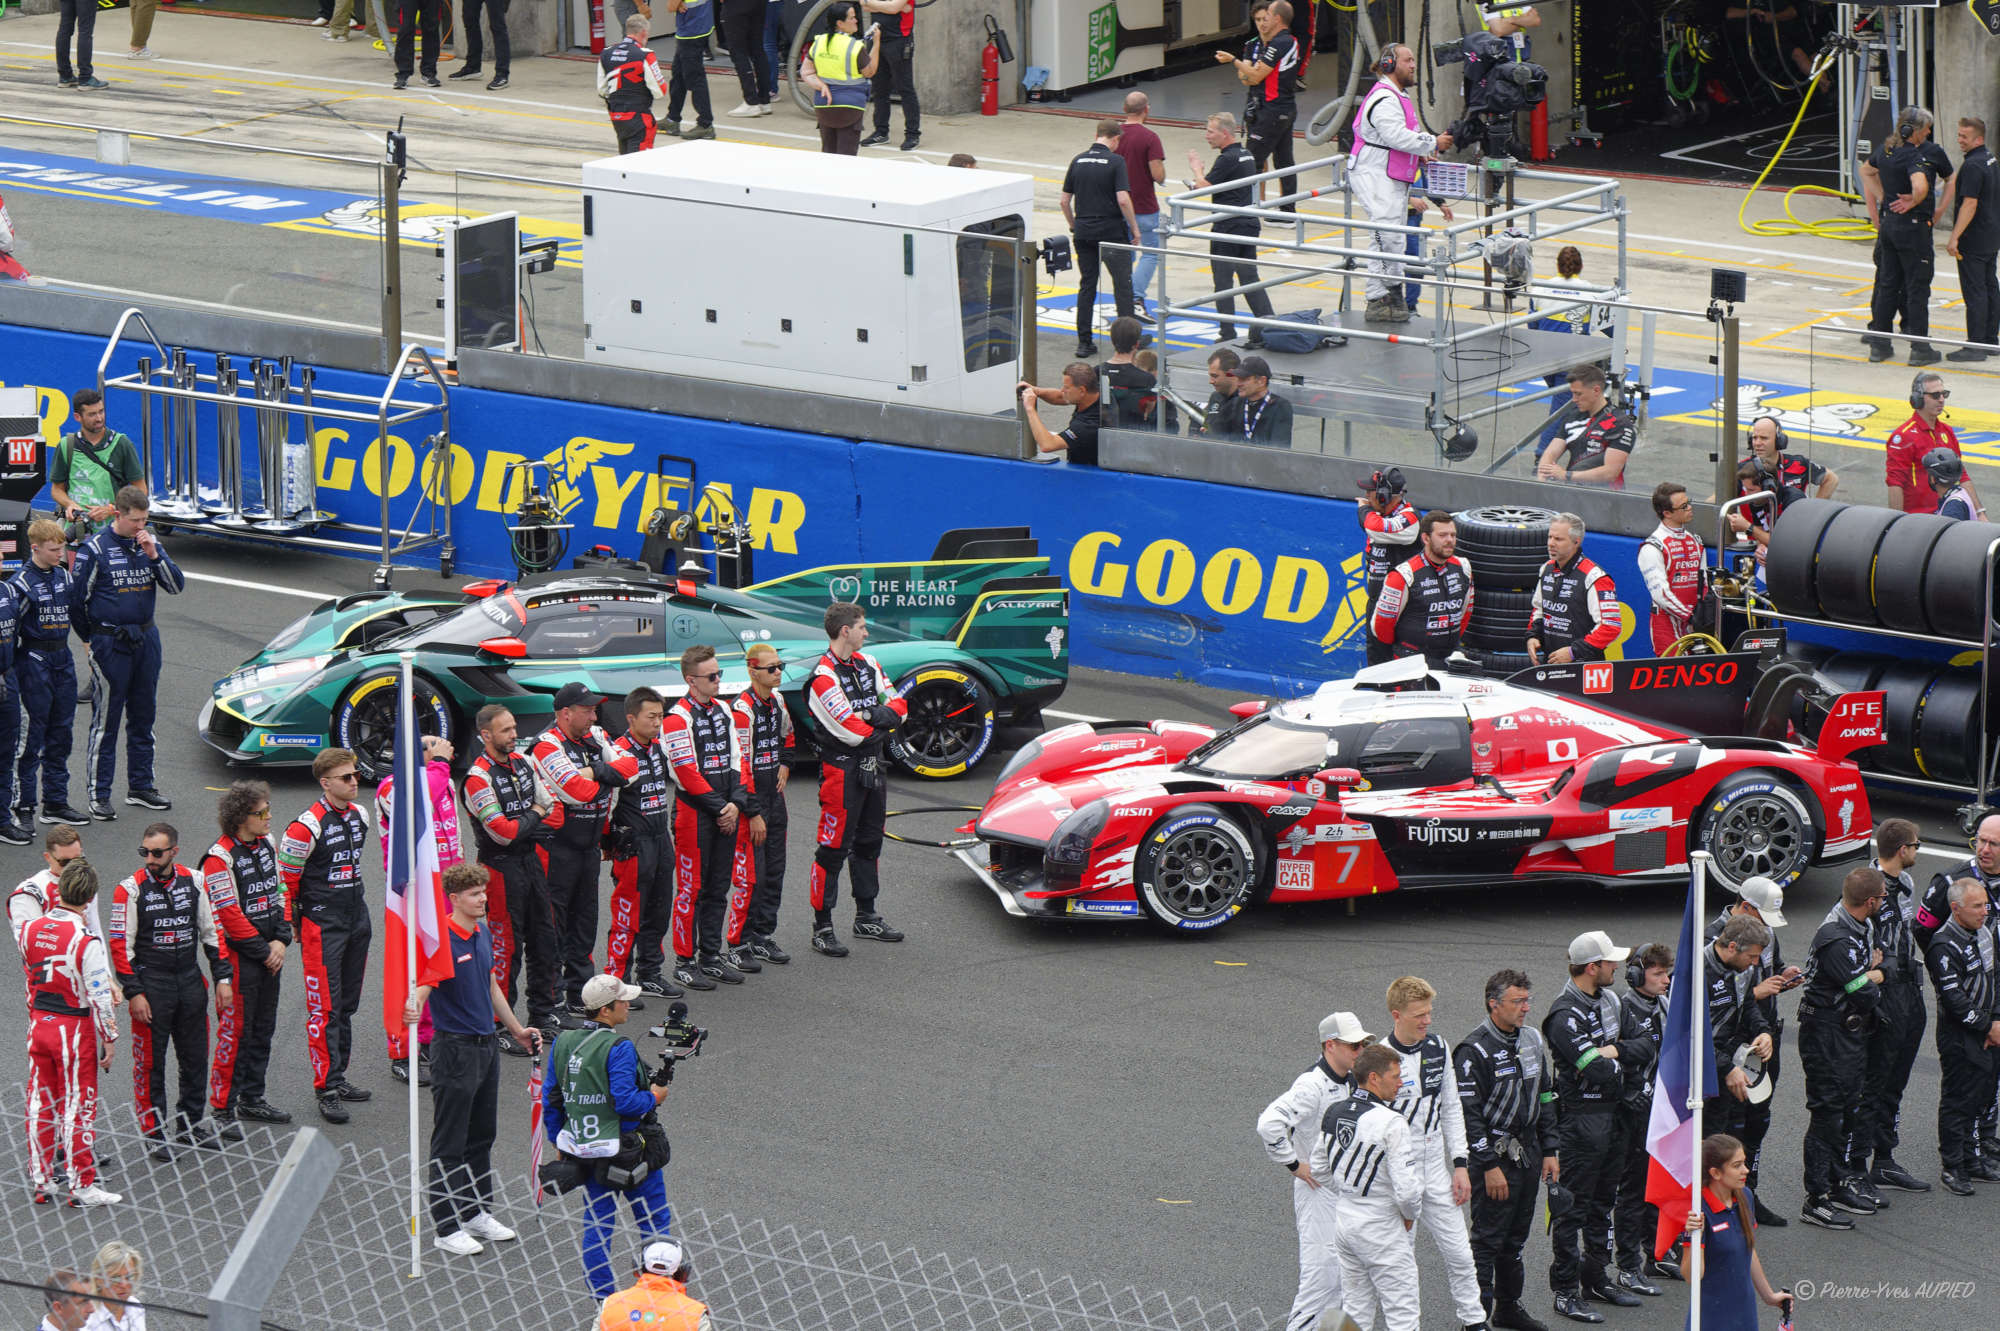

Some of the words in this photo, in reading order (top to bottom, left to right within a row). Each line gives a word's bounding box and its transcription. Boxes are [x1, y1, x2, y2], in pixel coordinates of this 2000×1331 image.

[1089, 54, 1099, 79] ON
[9, 440, 34, 462] HY
[869, 580, 902, 593] THE
[906, 580, 958, 592] HEART
[540, 598, 565, 607] ALEX
[870, 595, 889, 607] OF
[892, 594, 956, 607] RACING
[1429, 598, 1463, 613] DENSO
[1585, 669, 1610, 689] HY
[1629, 661, 1739, 691] DENSO
[1468, 684, 1494, 693] ZENT
[1835, 702, 1881, 717] JFE
[340, 706, 352, 750] MICHELIN
[968, 726, 993, 765] MICHELIN
[1311, 783, 1320, 794] E
[1728, 784, 1771, 801] MICHELIN
[1113, 807, 1153, 817] AISIN
[1267, 806, 1312, 816] RAYS
[1619, 808, 1661, 820] WEC
[1169, 817, 1213, 832] MICHELIN
[1408, 818, 1469, 846] FUJITSU
[1279, 863, 1311, 873] HYPER
[1336, 845, 1361, 884] 7
[247, 875, 277, 894] DENSO
[676, 854, 693, 914] DENSO
[734, 851, 749, 909] DENSO
[1279, 872, 1311, 887] CAR
[1086, 903, 1133, 912] MICHELIN
[153, 915, 191, 928] DENSO
[1183, 916, 1227, 928] MICHELIN
[1918, 909, 1927, 922] C
[611, 897, 632, 956] DENSO
[305, 975, 325, 1039] DENSO
[216, 1003, 235, 1064] DENSO
[81, 1085, 96, 1146] DENSO
